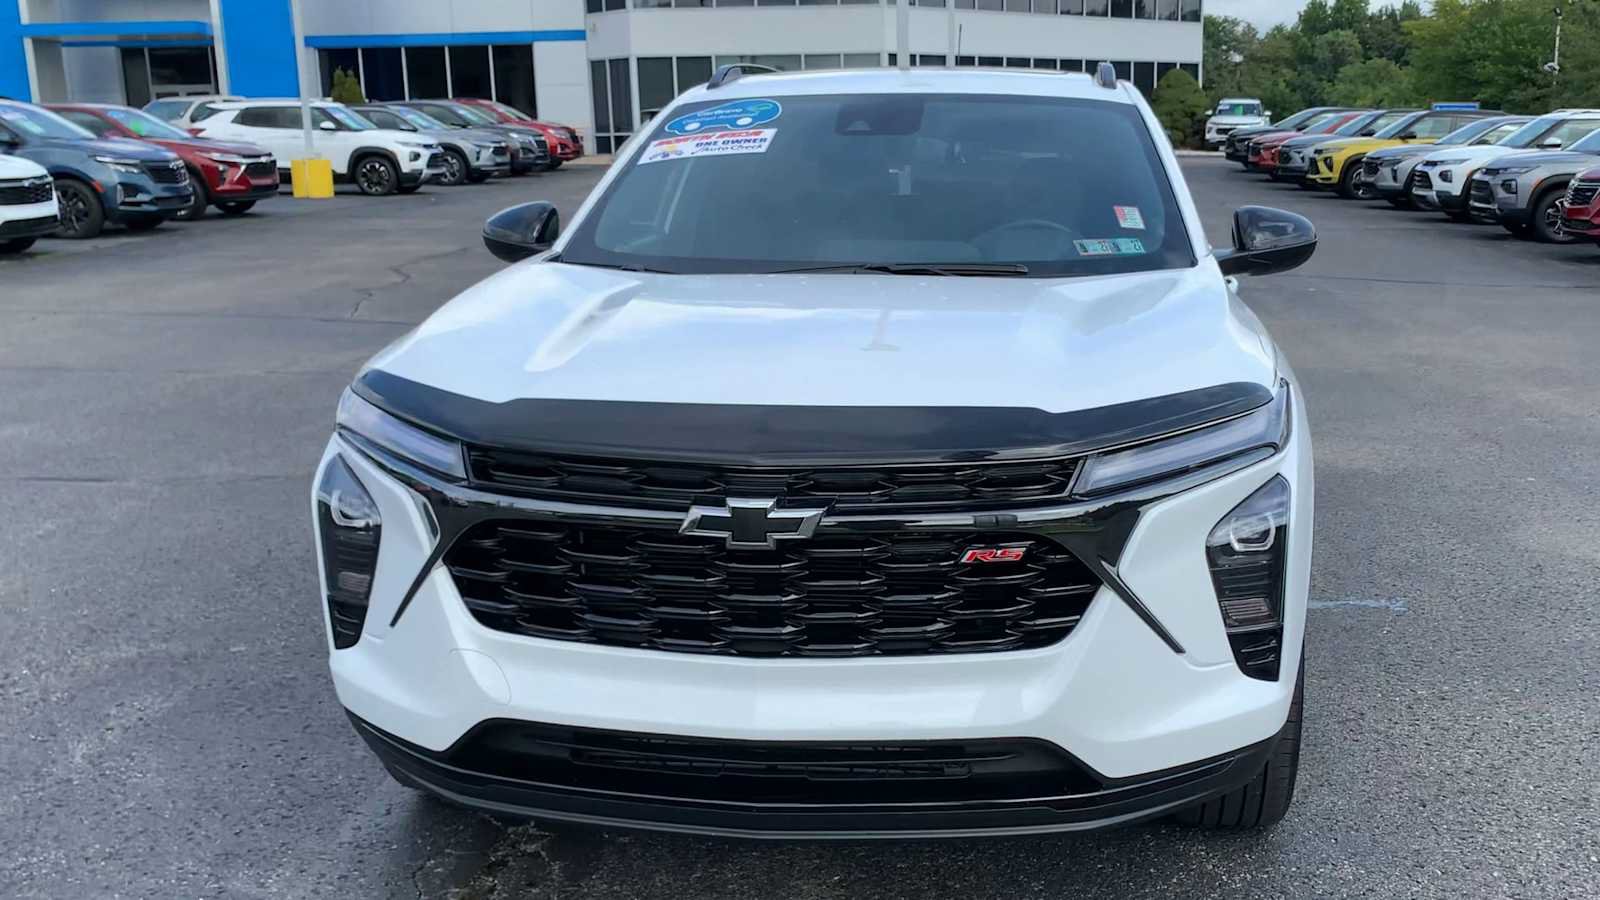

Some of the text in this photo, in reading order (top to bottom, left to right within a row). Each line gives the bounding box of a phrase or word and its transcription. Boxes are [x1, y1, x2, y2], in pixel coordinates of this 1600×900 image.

[695, 140, 719, 149] ONE
[721, 137, 768, 147] OWNER
[961, 547, 1026, 563] RS
